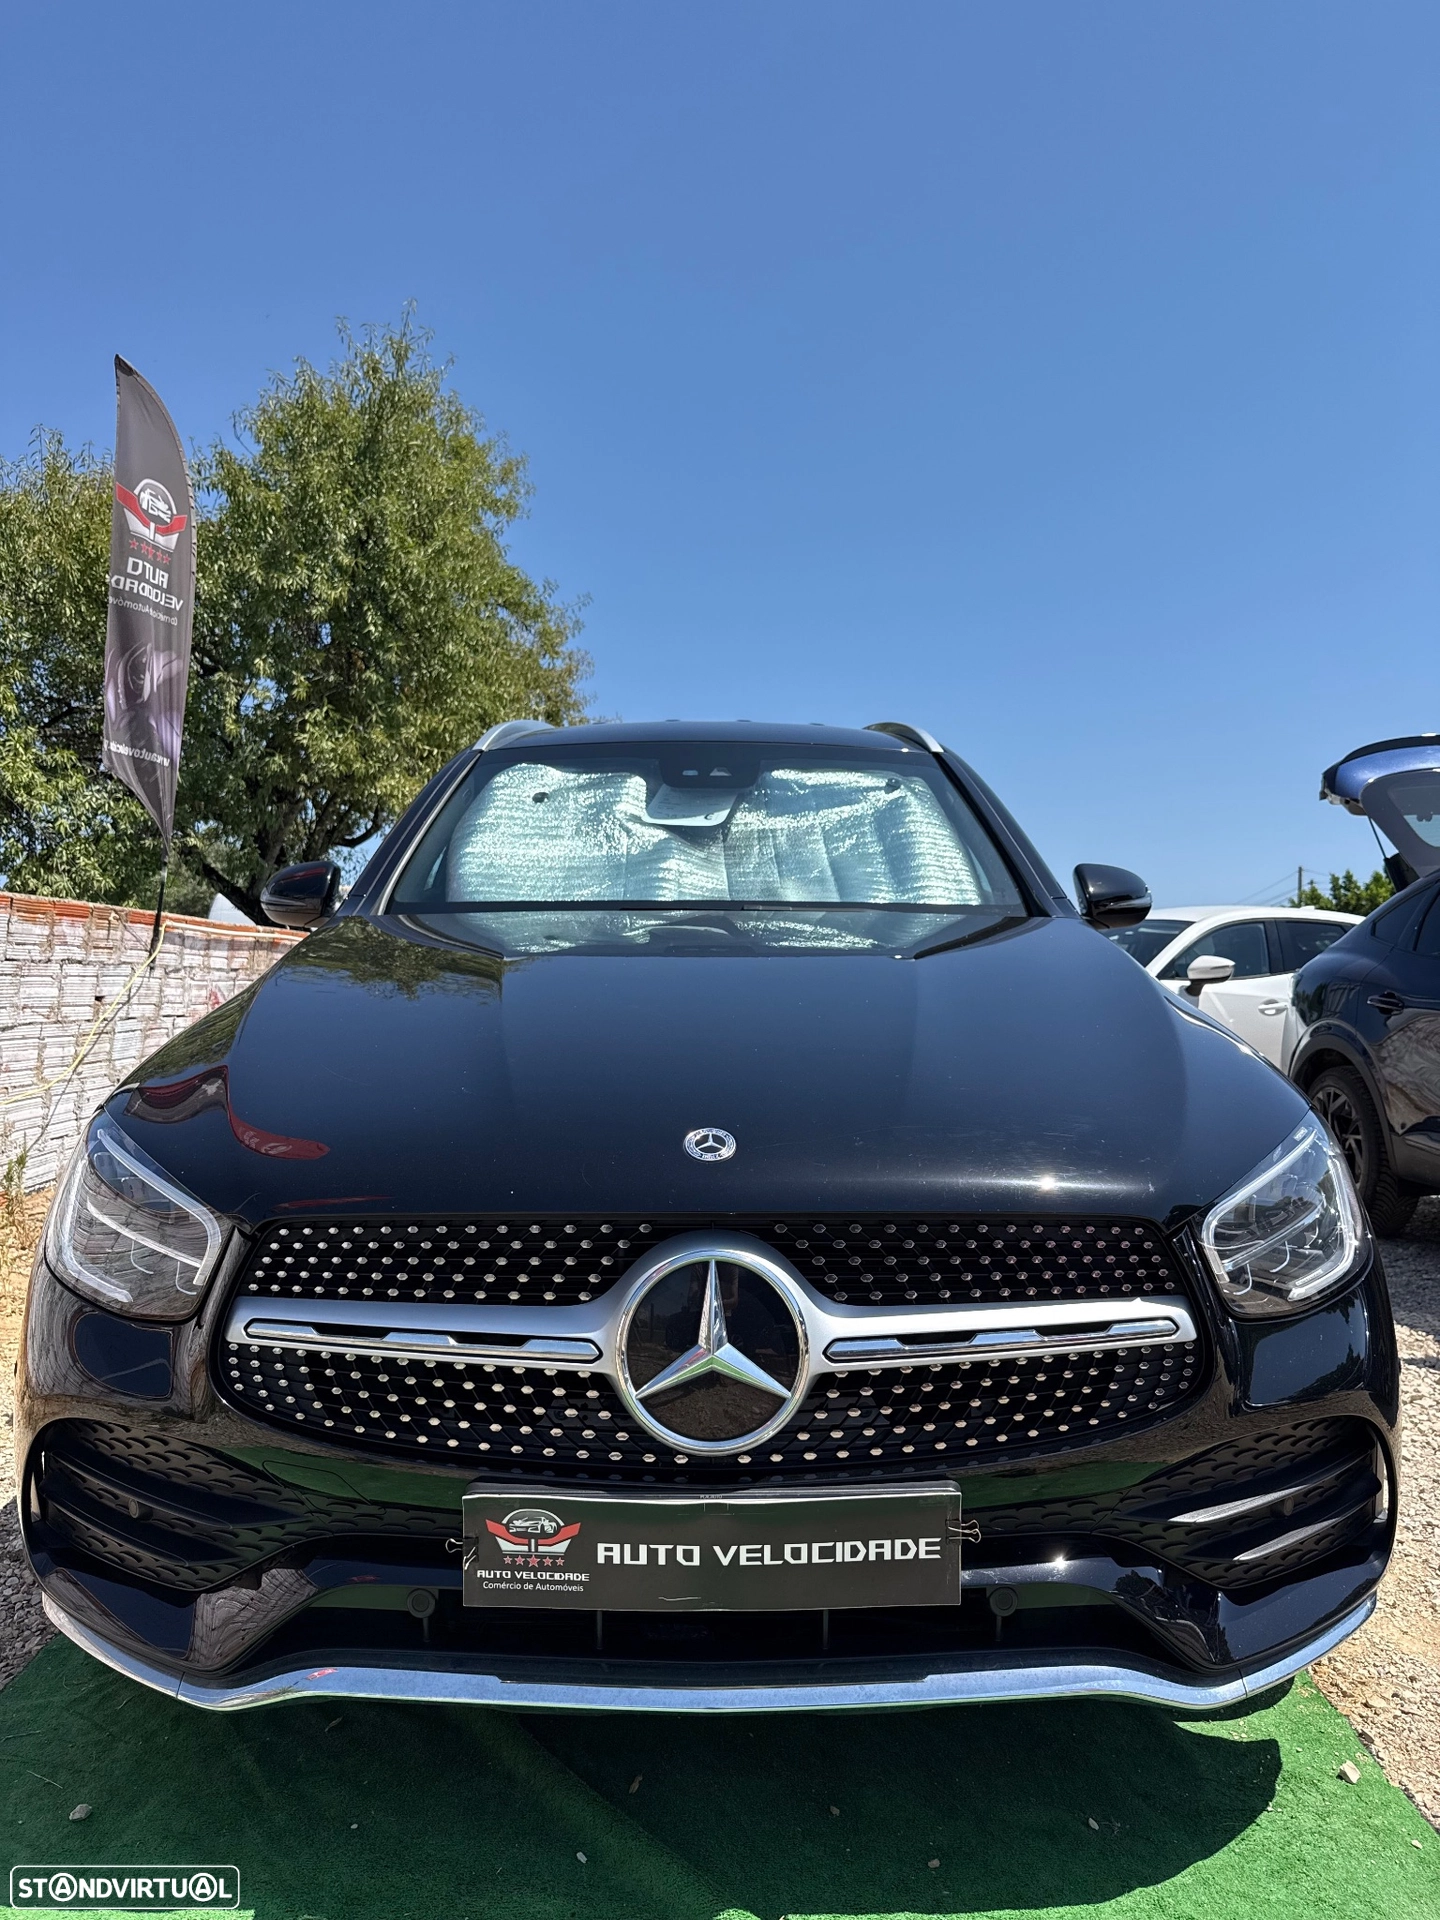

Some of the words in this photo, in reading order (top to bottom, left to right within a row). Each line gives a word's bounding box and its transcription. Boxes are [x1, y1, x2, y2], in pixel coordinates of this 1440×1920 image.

[597, 1542, 701, 1567] AUTO
[713, 1537, 942, 1567] VELOCIDADE
[476, 1569, 512, 1579] AUTO
[514, 1571, 590, 1582] VELOCIDADE
[482, 1581, 522, 1590] Comércio
[523, 1582, 534, 1590] de
[535, 1582, 584, 1592] Automóveis
